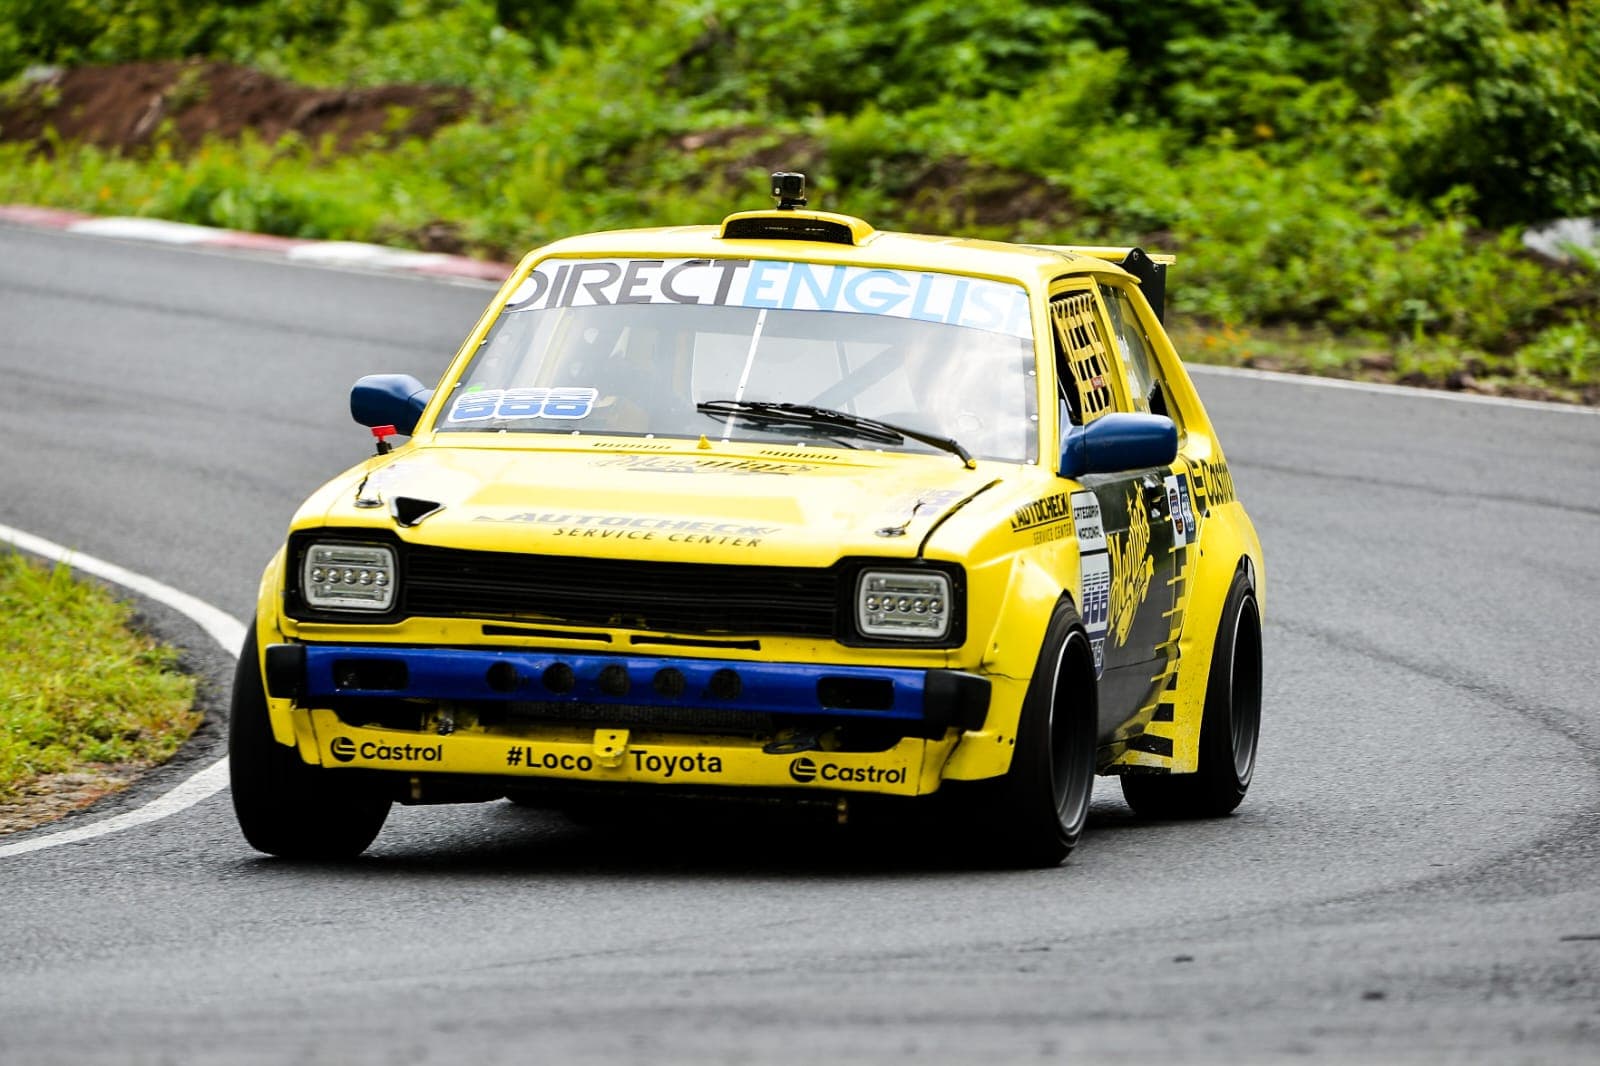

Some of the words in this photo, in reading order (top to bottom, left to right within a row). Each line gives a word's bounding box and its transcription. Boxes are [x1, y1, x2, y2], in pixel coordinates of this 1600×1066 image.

[1200, 459, 1234, 507] Castro
[1014, 493, 1069, 528] AUTOCHECK
[505, 511, 770, 536] AUTOCHECK
[1033, 527, 1053, 545] SERVICE
[1054, 522, 1072, 540] CENTER
[552, 527, 655, 542] SERVICE
[667, 533, 764, 548] CENTER
[360, 742, 443, 762] Castrol
[506, 746, 593, 772] #Loco
[629, 750, 723, 778] Toyota
[820, 763, 907, 784] Castrol
